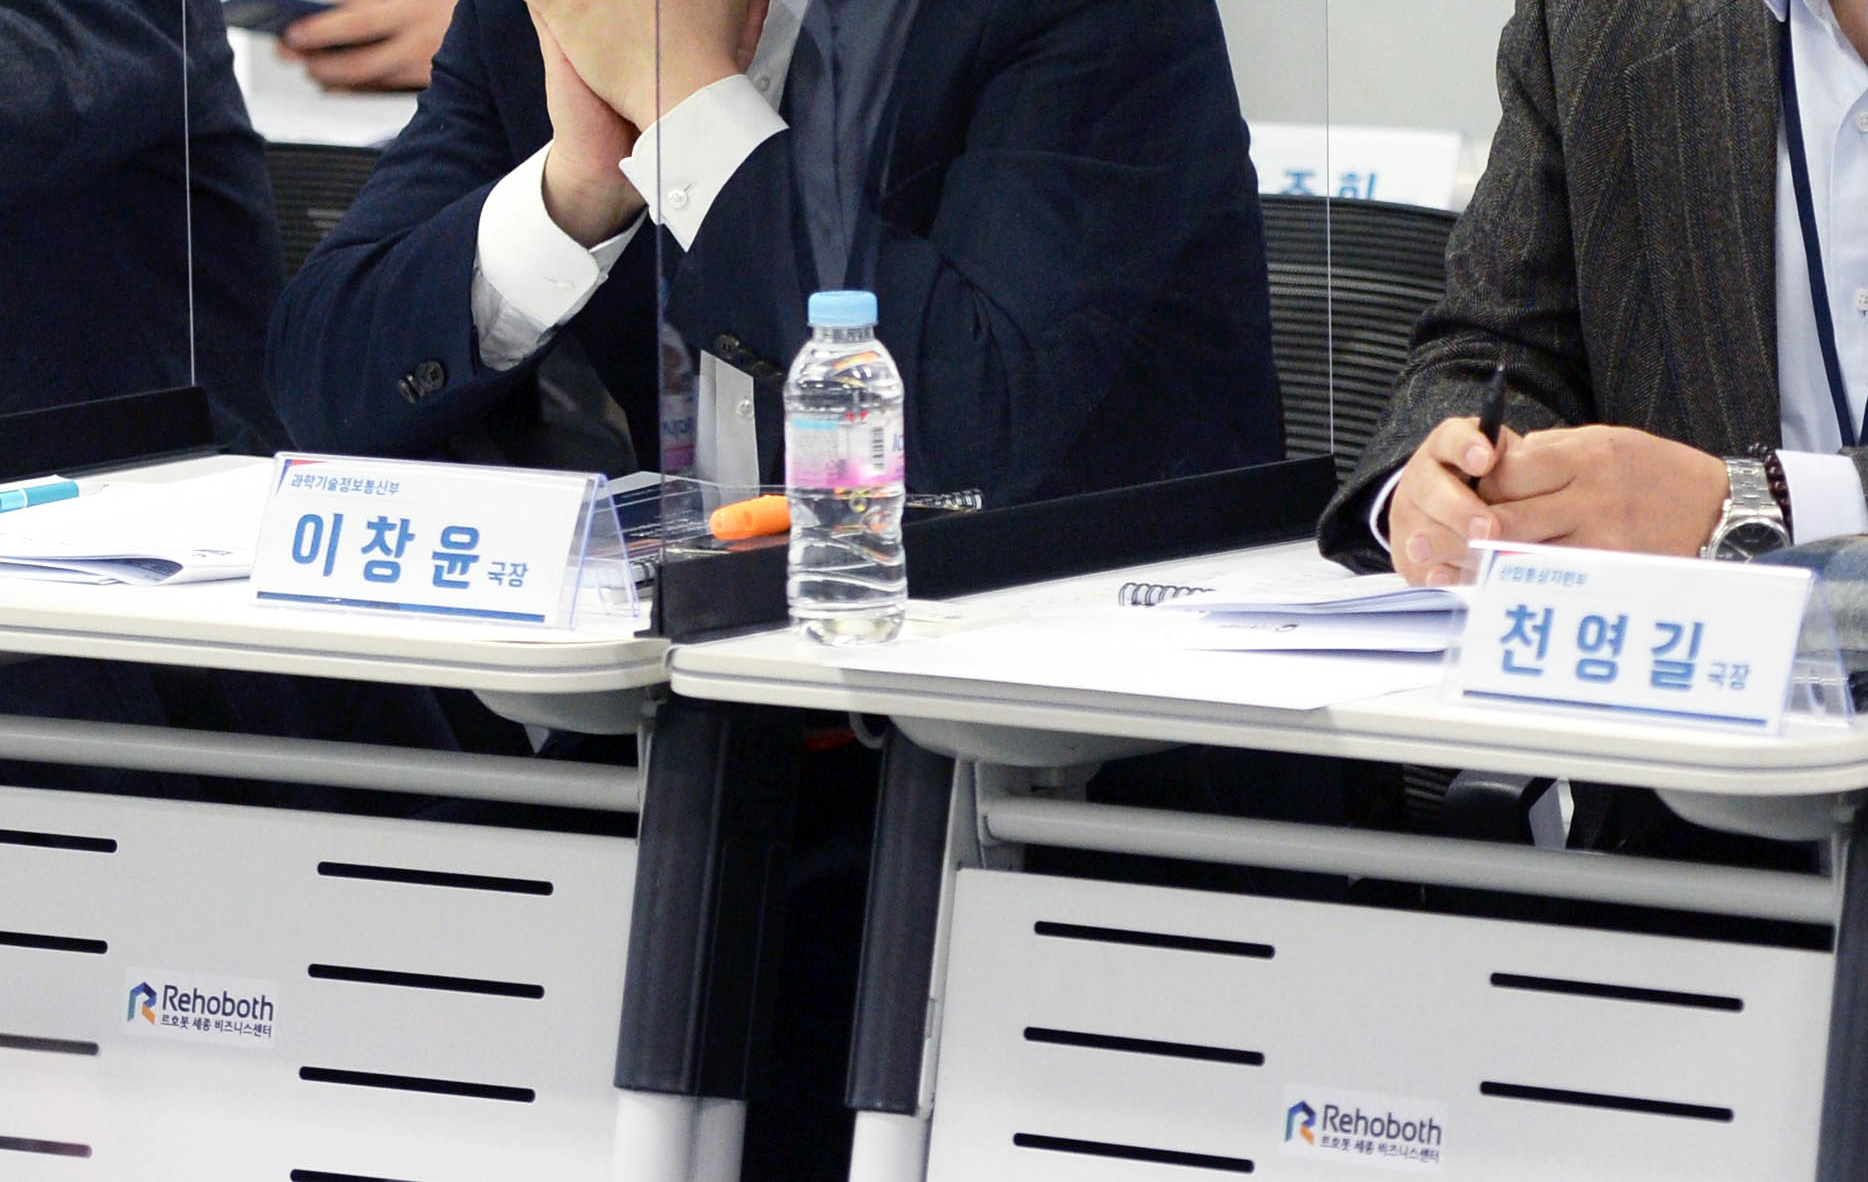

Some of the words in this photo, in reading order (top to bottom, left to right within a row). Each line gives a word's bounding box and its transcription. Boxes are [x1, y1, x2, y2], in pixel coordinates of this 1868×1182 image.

[291, 474, 399, 495] 과학기술정보통신부
[292, 513, 480, 589] 이창윤
[487, 562, 527, 587] 국장
[1500, 604, 1704, 690] 천영길
[1708, 662, 1750, 688] 국장
[162, 984, 274, 1021] Rehoboth
[214, 1019, 272, 1038] 비즈니스센터
[1322, 1104, 1442, 1145] Rehoboth
